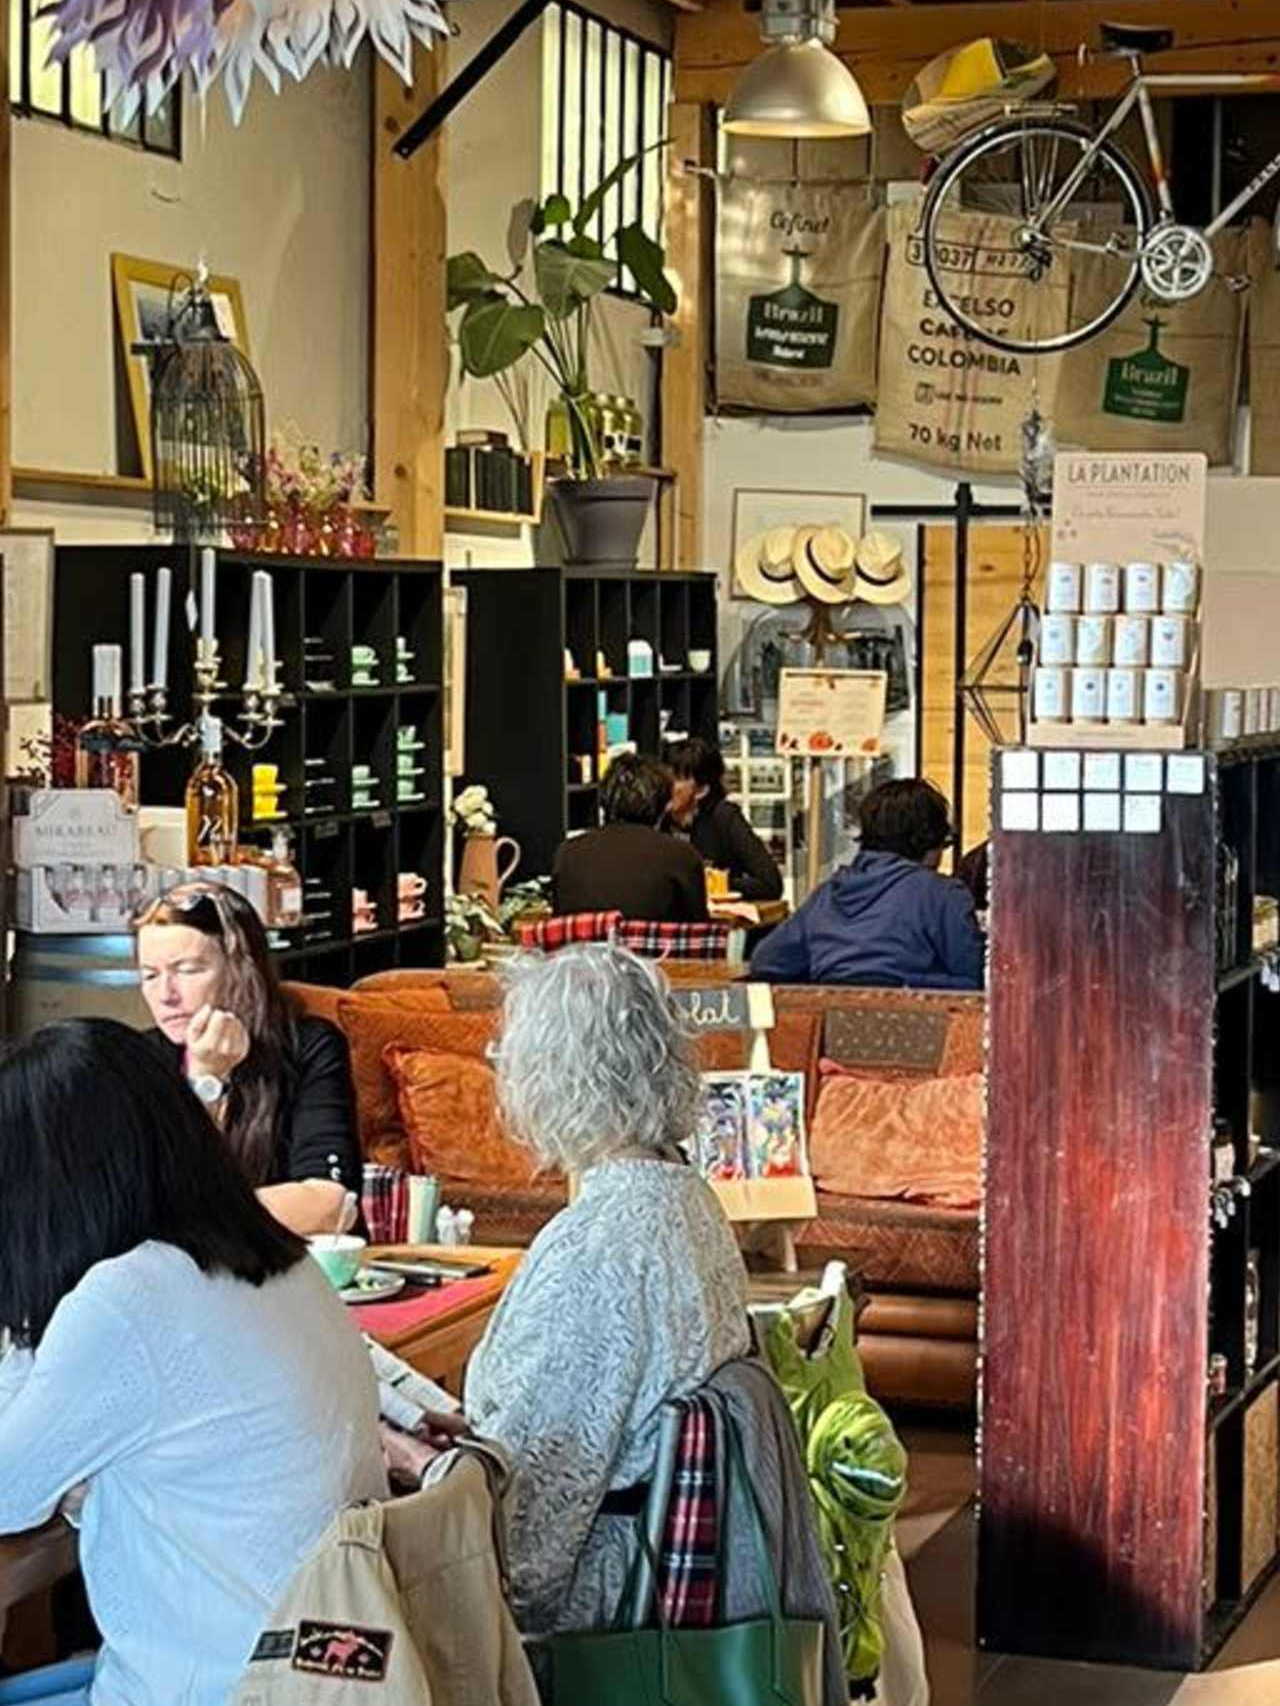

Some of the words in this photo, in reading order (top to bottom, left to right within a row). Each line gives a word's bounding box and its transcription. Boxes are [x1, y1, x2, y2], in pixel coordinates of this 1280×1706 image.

[764, 303, 824, 323] Brazil
[907, 343, 1022, 376] COLOMBIA
[1121, 363, 1179, 386] Brazil
[908, 424, 932, 442] 70
[936, 427, 961, 452] kg
[967, 431, 1002, 452] Net
[1068, 463, 1087, 483] LA
[1090, 462, 1190, 484] PLANTATION
[34, 823, 117, 837] MIRABEAU
